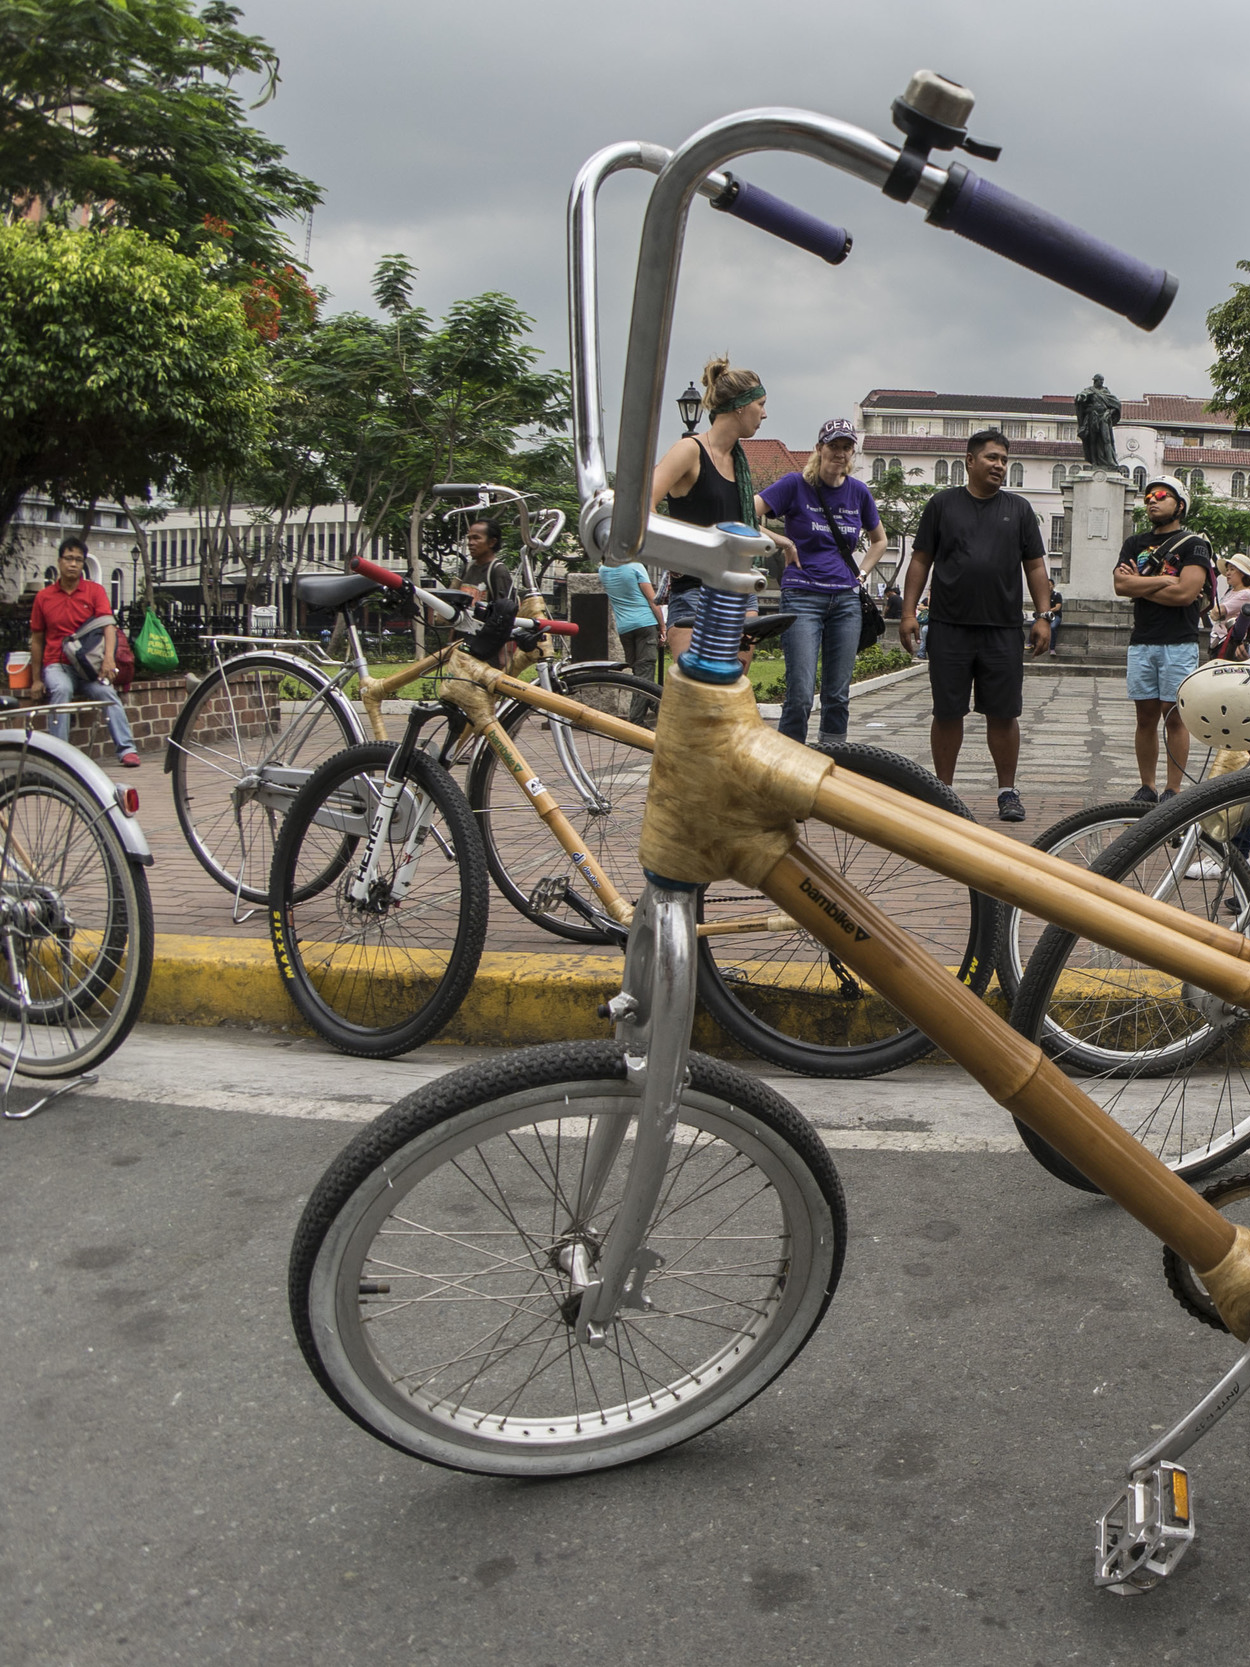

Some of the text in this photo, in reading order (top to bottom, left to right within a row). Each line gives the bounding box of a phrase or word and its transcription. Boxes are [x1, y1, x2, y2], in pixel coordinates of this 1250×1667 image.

[488, 729, 515, 765] bambike
[798, 876, 856, 935] bambike
[273, 910, 296, 979] MAXXIS
